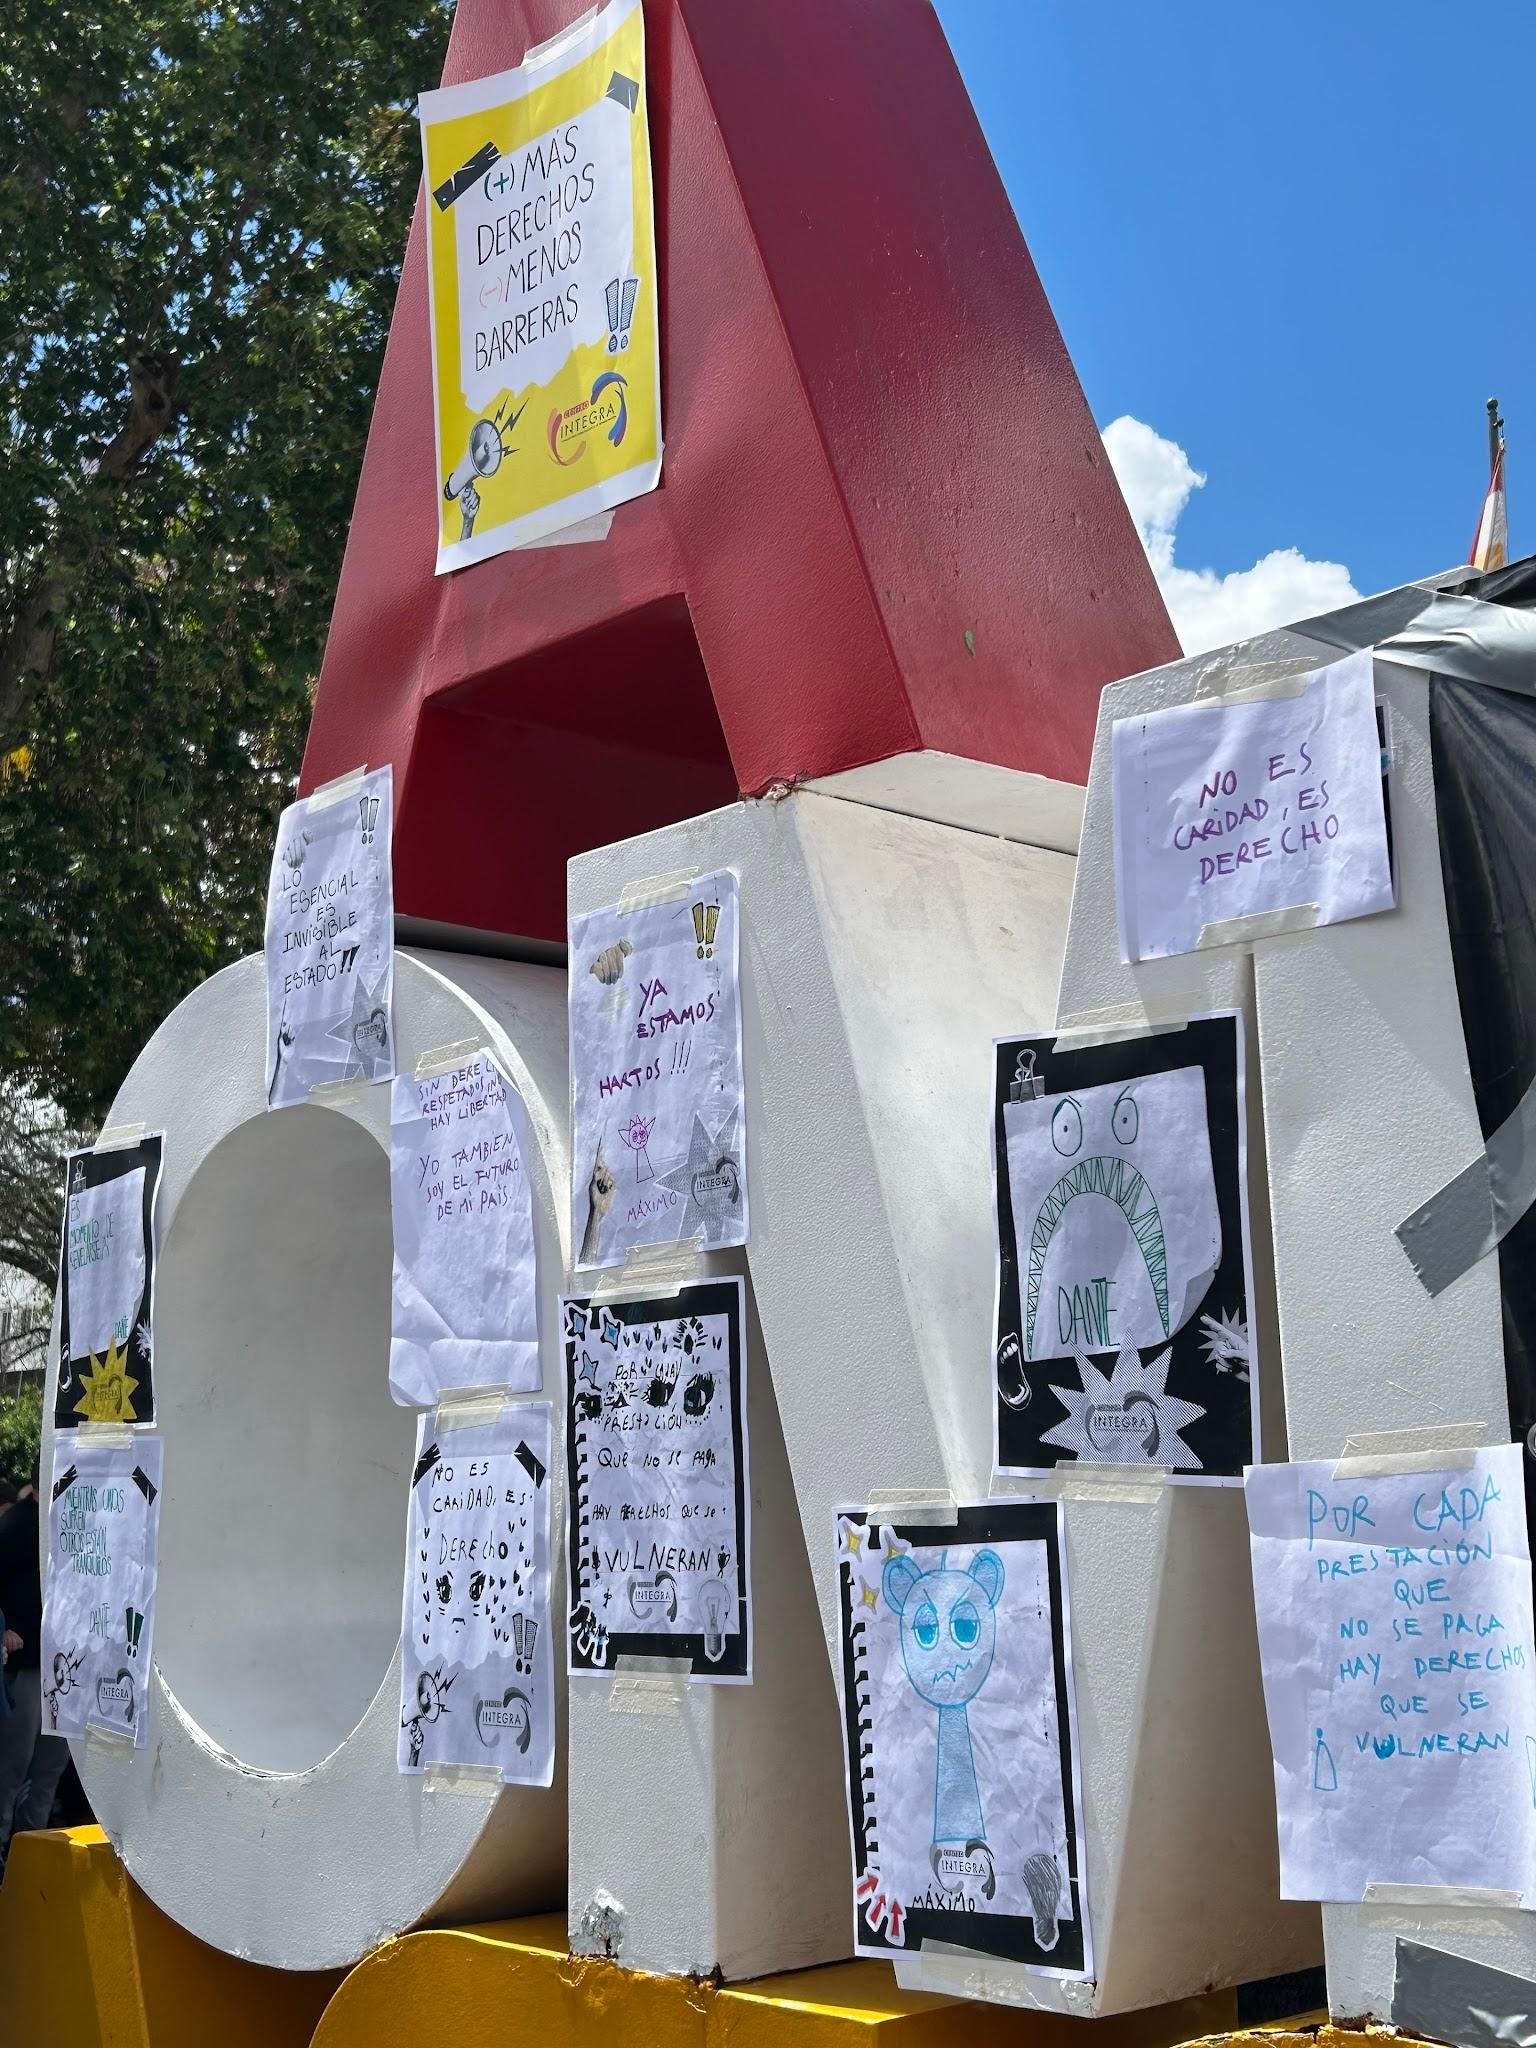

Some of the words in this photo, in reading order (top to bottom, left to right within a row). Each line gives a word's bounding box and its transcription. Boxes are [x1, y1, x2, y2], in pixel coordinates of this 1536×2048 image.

[521, 125, 579, 192] MÁS
[477, 162, 596, 266] DERECHOS
[505, 221, 582, 302] MENOS
[474, 282, 579, 373] BARRERAS
[560, 402, 615, 440] INTEGRA
[1200, 770, 1238, 809] NO
[1268, 742, 1313, 782] ES
[1298, 780, 1330, 811] ES
[1199, 814, 1340, 885] DERECHO
[283, 869, 302, 892] LO
[290, 871, 359, 915] ESENCIAL
[316, 902, 336, 923] ES
[282, 911, 358, 954] INVISIBLE
[319, 943, 341, 962] AL
[639, 978, 668, 1018] YA
[637, 993, 715, 1038] ESTAMOS
[419, 1078, 440, 1101] SIN
[430, 1112, 451, 1131] HAY
[458, 1088, 507, 1120] LIBERTAD
[419, 1155, 440, 1189] YO
[427, 1181, 444, 1203] SOY
[453, 1175, 469, 1190] EL
[475, 1158, 519, 1185] FUTURO
[696, 1175, 732, 1190] INTEGRA
[438, 1201, 452, 1222] DE
[627, 1191, 677, 1222] MÁXIMO
[1058, 1276, 1121, 1347] DANTE
[1094, 1416, 1148, 1429] INTEGRA
[431, 1463, 454, 1488] NO
[469, 1462, 491, 1477] ES
[643, 1454, 660, 1468] NO
[1307, 1489, 1376, 1552] POR
[1413, 1473, 1502, 1531] CADA
[604, 1539, 712, 1573] VULNERAN
[1317, 1532, 1492, 1582] PRESTACIÓN
[635, 1590, 671, 1601] INTEGRA
[1394, 1578, 1450, 1609] QUE
[89, 1602, 111, 1640] DANTE
[1340, 1617, 1369, 1639] NO
[1393, 1618, 1422, 1641] SE
[1443, 1613, 1505, 1640] PAGA
[1340, 1653, 1381, 1685] HAY
[1415, 1645, 1526, 1679] DERECHOS
[102, 1686, 129, 1699] INTEGRA
[1380, 1694, 1429, 1721] QUE
[1458, 1691, 1489, 1716] SE
[482, 1711, 522, 1726] INTEGRA
[1356, 1726, 1510, 1759] VULNERAN
[942, 1860, 986, 1875] INTEGRA
[912, 1884, 976, 1912] MÁXIMO
